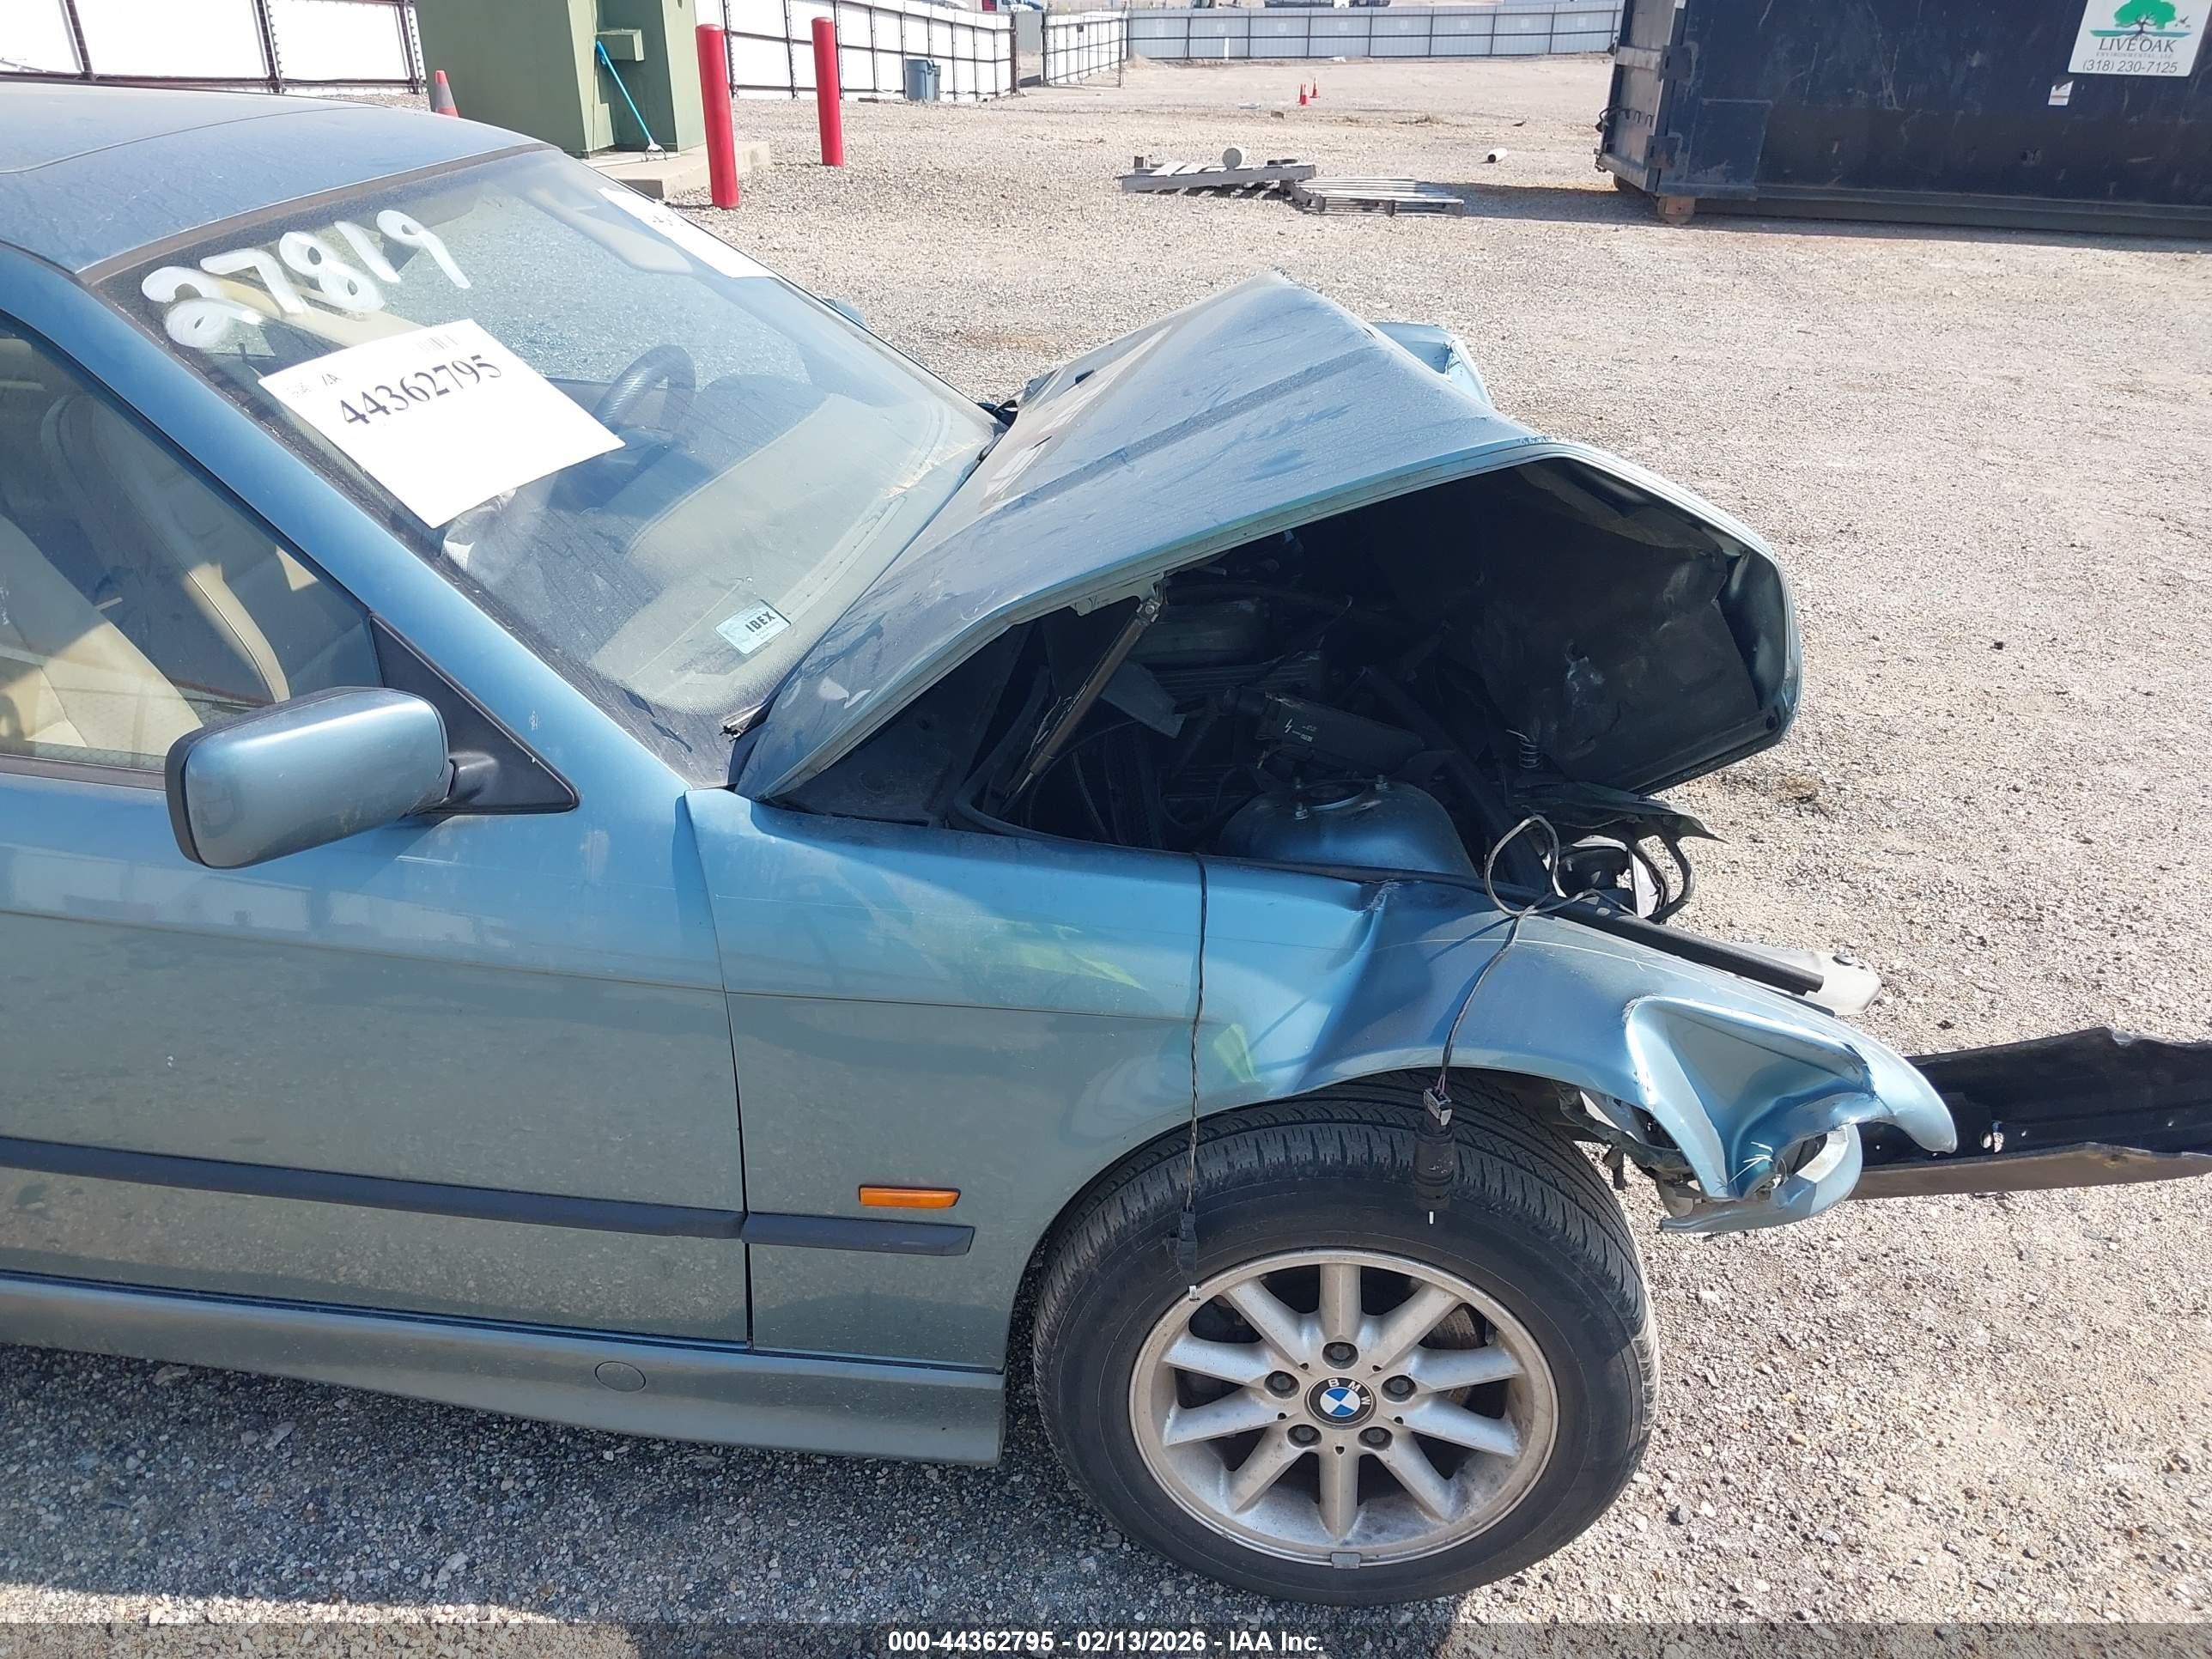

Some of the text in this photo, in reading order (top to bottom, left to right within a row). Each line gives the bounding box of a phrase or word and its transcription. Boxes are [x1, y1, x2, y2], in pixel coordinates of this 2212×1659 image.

[2082, 58, 2178, 74] (318) 230-7125
[141, 209, 472, 349] 27819
[340, 354, 501, 425] 44362795
[1328, 1378, 1372, 1406] BMW
